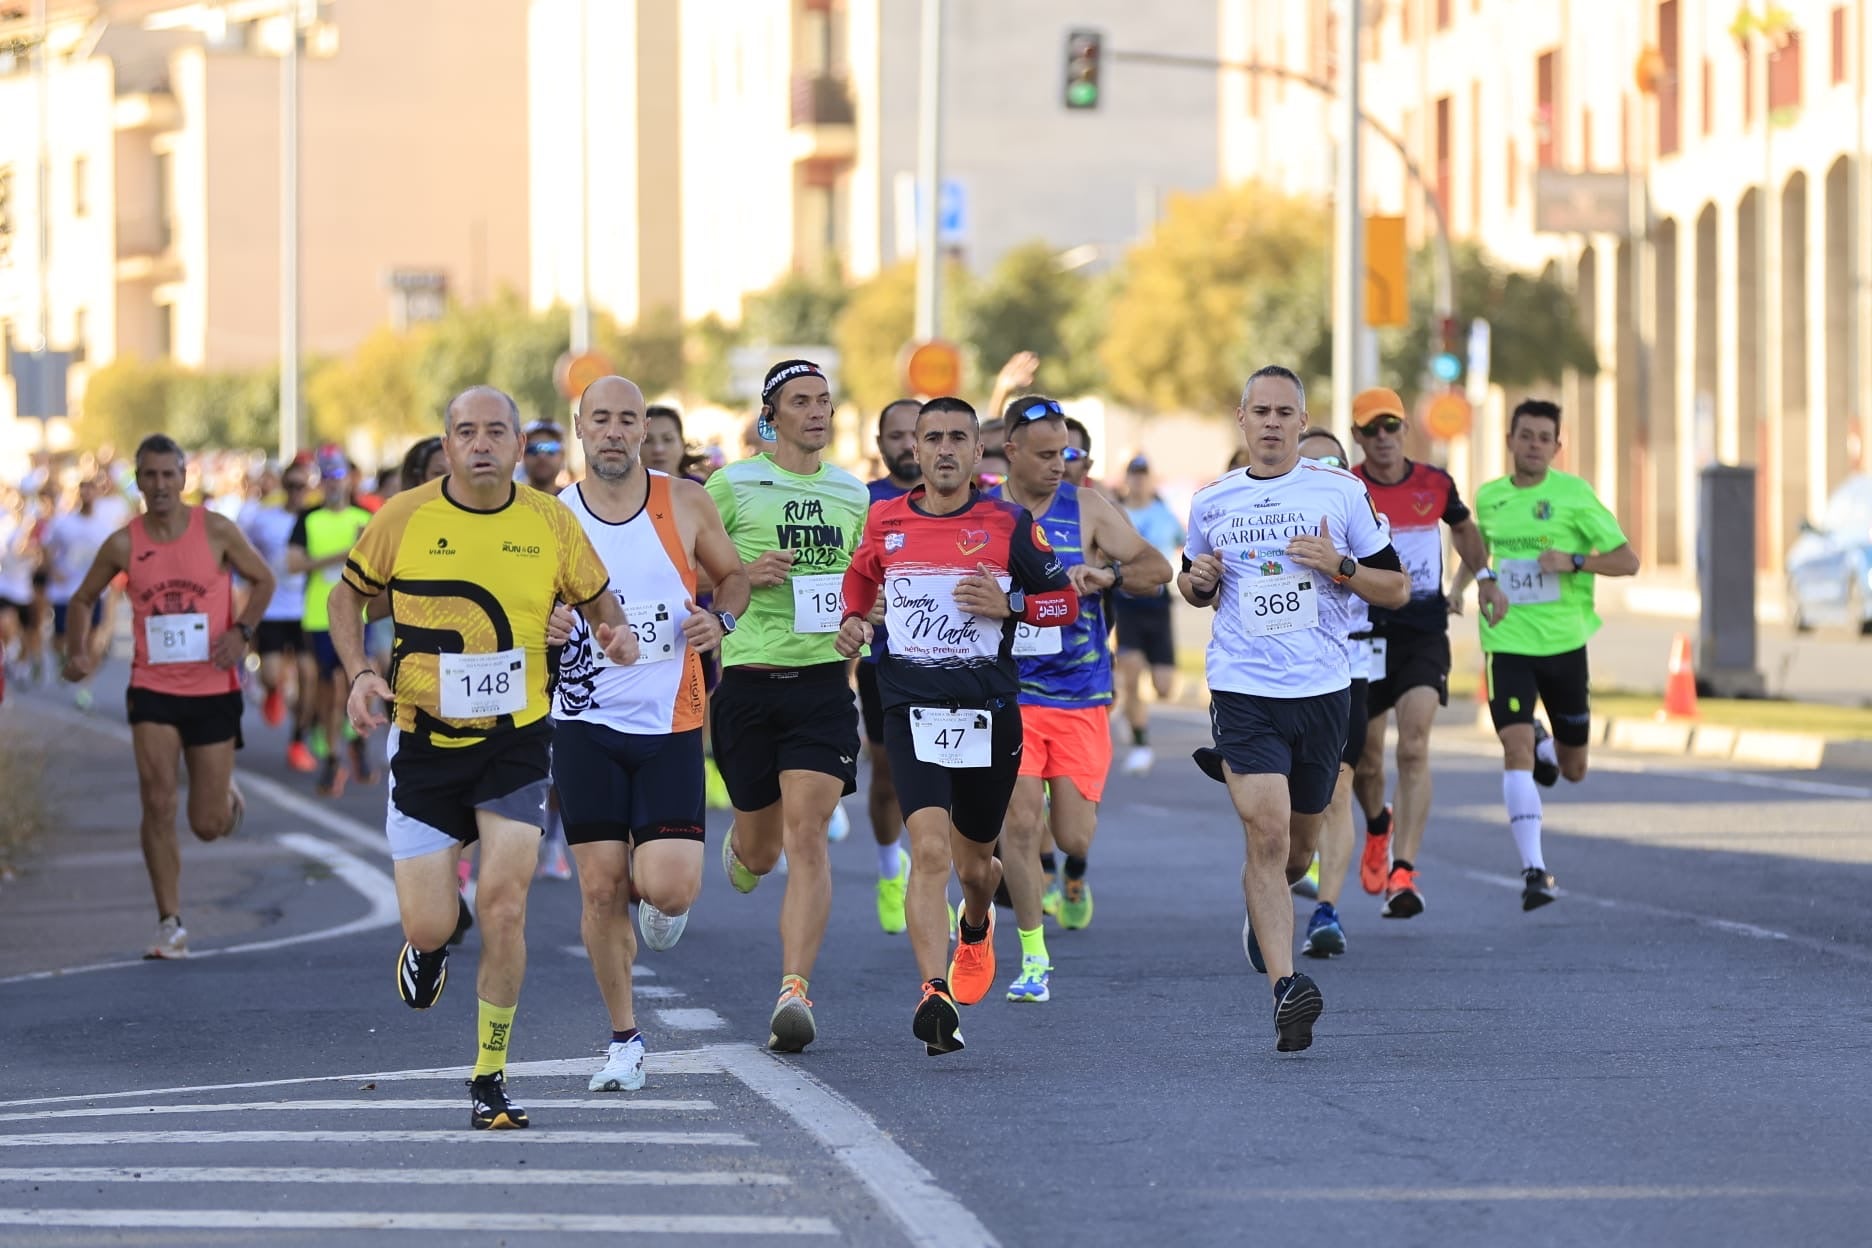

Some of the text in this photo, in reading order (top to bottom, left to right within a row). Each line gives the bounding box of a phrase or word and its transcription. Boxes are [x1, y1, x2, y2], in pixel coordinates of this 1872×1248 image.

[782, 499, 826, 524] RUTA
[1231, 512, 1305, 528] III CARRERA
[776, 524, 844, 550] VETONA
[1215, 525, 1322, 547] GVARDIA CIVI
[791, 547, 837, 567] 2025
[1510, 573, 1544, 589] 541
[812, 592, 842, 614] 19
[892, 577, 939, 613] Simón
[1254, 591, 1300, 617] 368
[905, 609, 980, 645] Martín
[163, 631, 186, 649] 81
[460, 671, 510, 697] 148
[934, 728, 966, 749] 47
